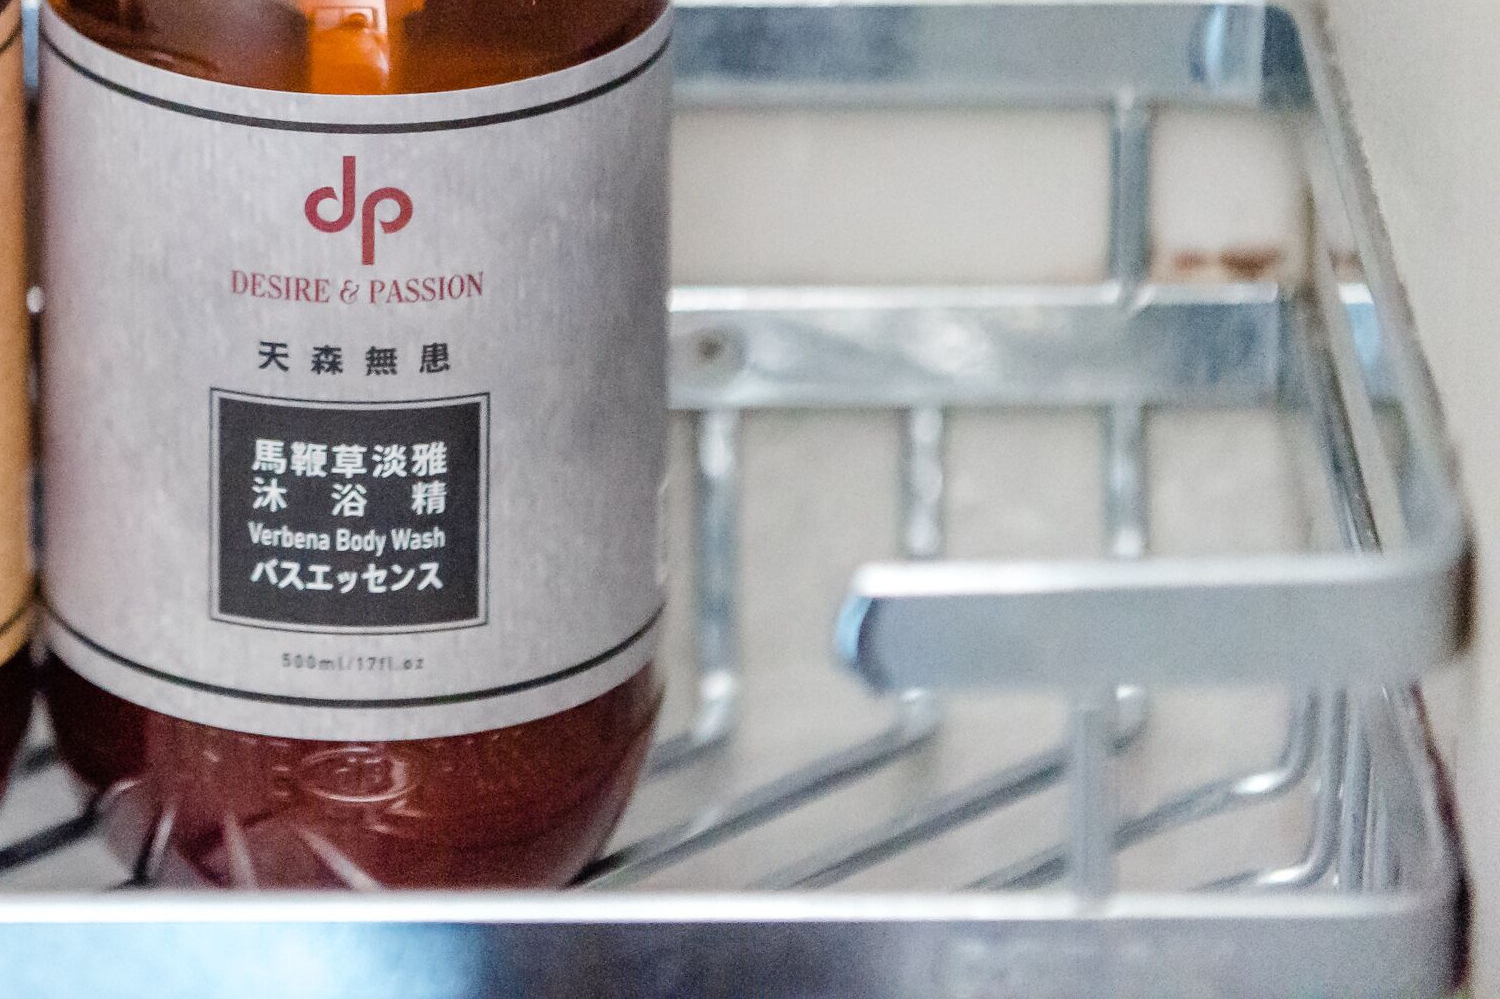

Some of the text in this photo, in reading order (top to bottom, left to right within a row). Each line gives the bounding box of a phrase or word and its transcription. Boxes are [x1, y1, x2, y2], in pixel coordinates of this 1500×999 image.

[231, 269, 484, 304] DESIRE & PASSION
[252, 438, 448, 478] 馬鞭草淡雅
[248, 521, 445, 556] Verbena Body Wash
